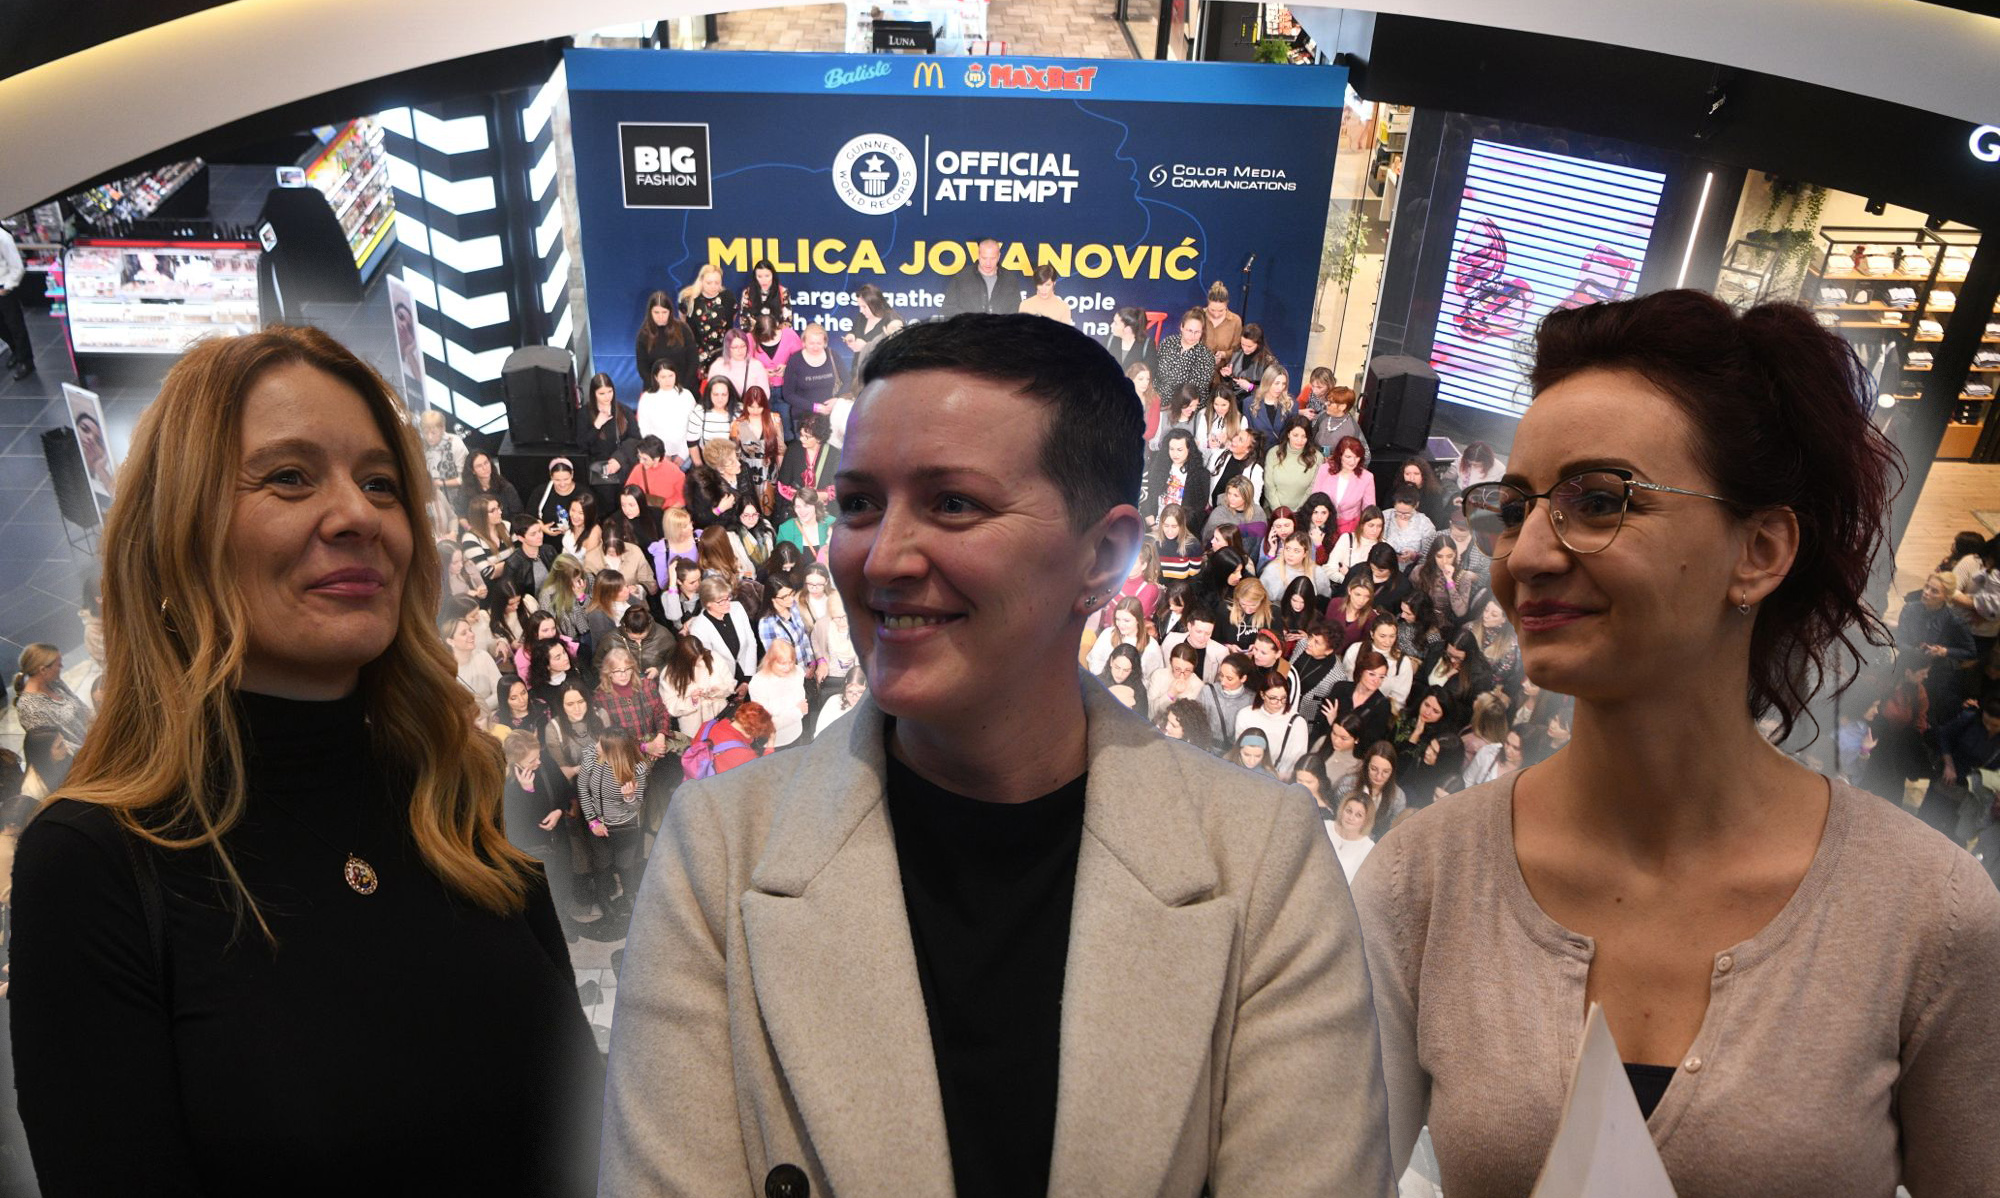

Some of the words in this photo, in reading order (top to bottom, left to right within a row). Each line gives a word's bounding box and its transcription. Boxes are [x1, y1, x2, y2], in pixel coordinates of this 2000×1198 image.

[889, 34, 916, 46] LUNA
[824, 60, 892, 89] Batiste
[634, 146, 696, 173] BIG
[846, 140, 904, 161] GUINNESS
[935, 150, 1080, 177] OFFICIAL
[636, 174, 697, 187] FASHION
[1171, 176, 1297, 191] COMMUNICATIONS
[1173, 164, 1228, 177] COLOR
[1233, 166, 1286, 179] MEDIA
[839, 170, 866, 206] WORLD
[870, 170, 912, 209] RECORDS
[934, 178, 1079, 204] ATTEMPT
[707, 237, 887, 275] MILICA
